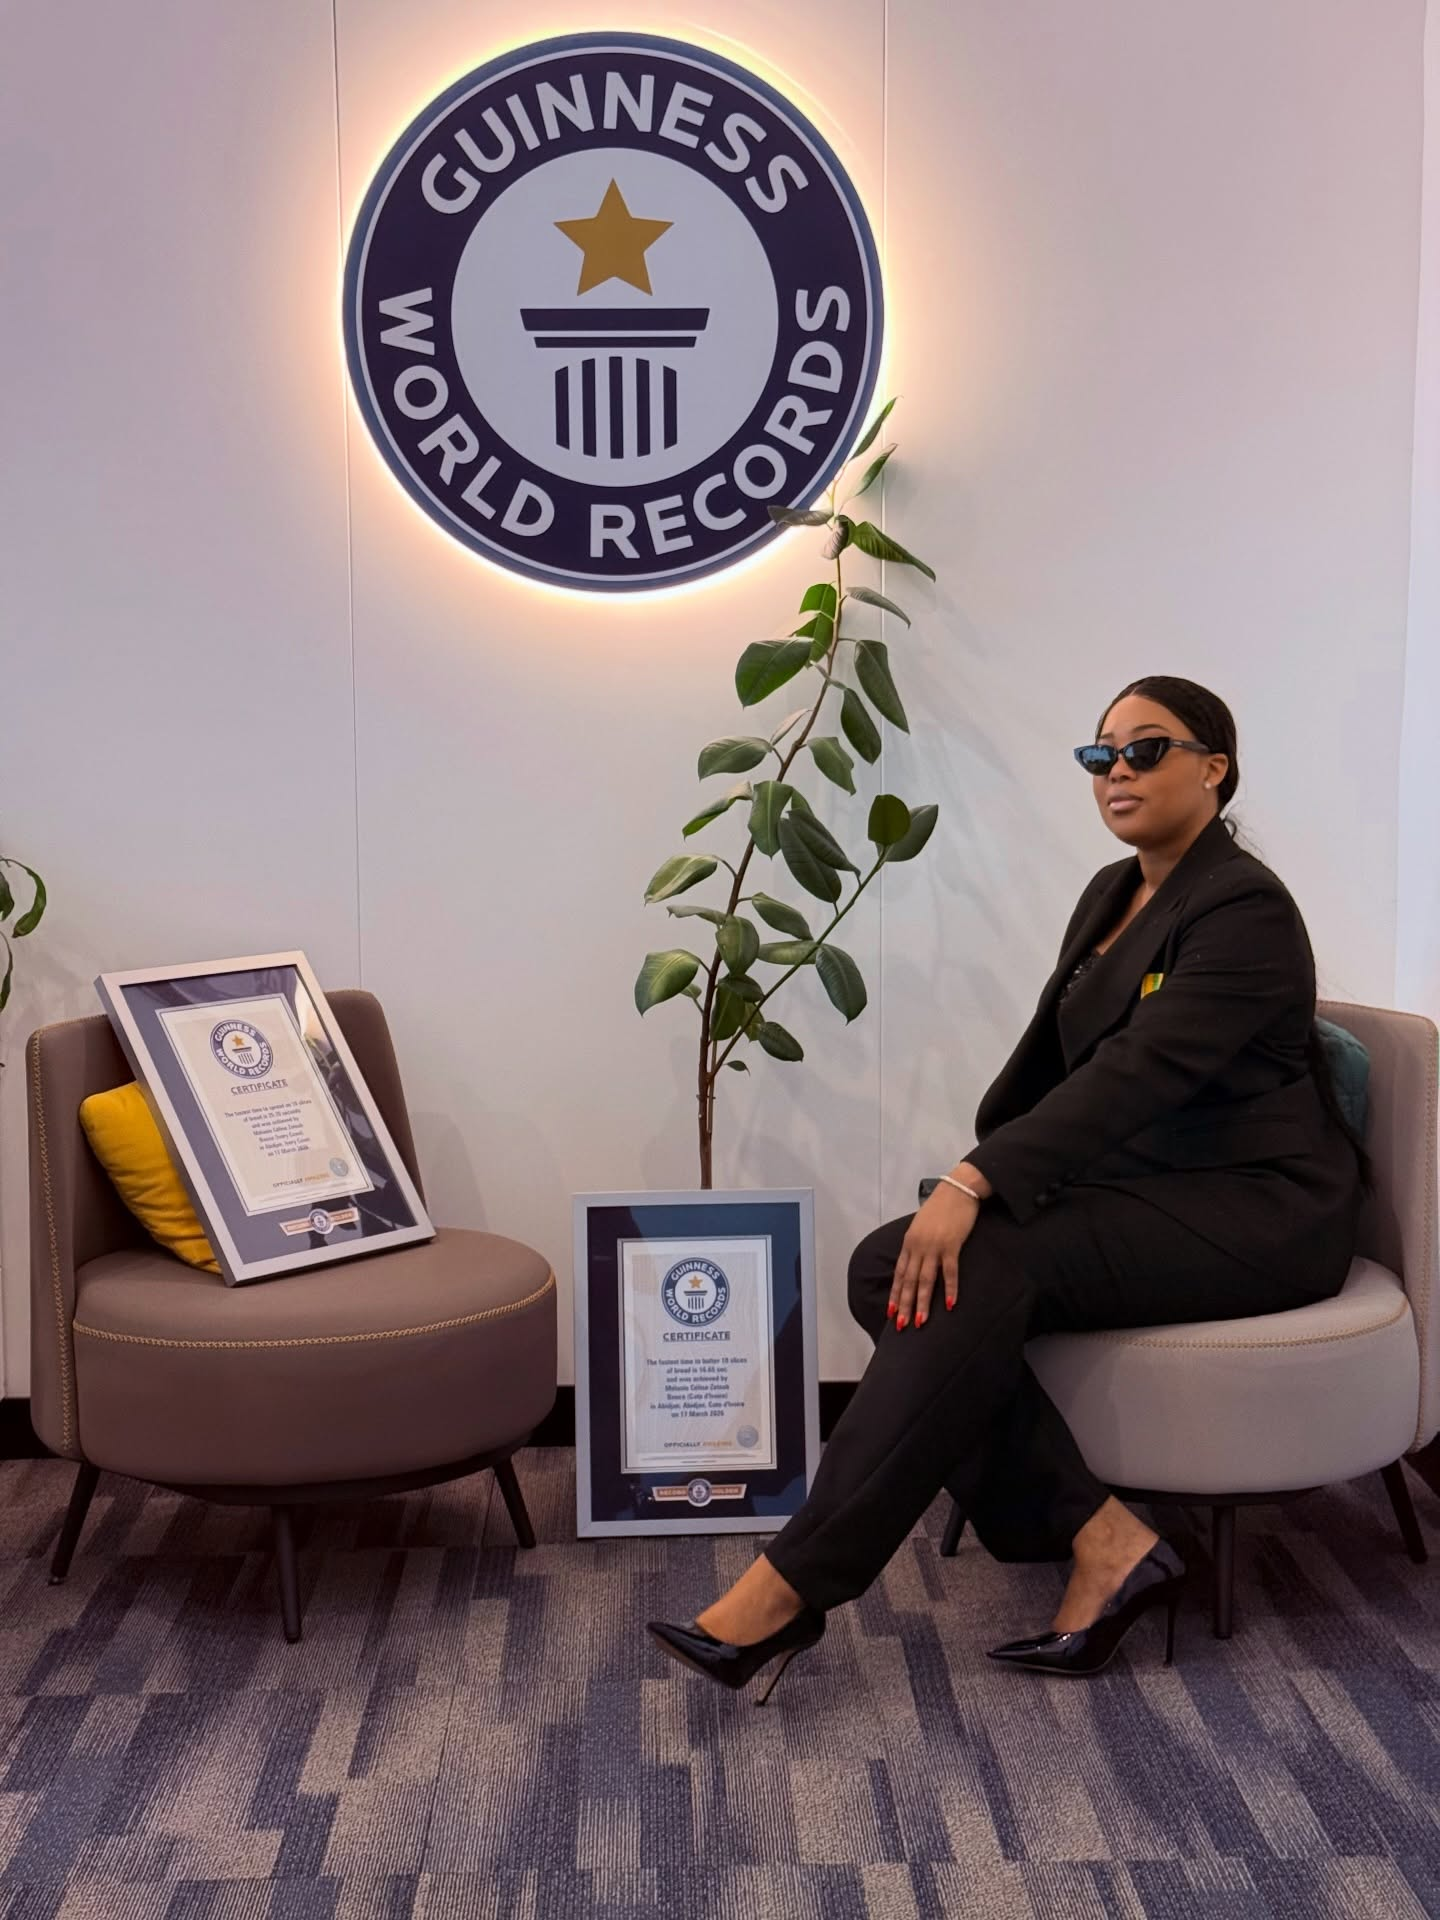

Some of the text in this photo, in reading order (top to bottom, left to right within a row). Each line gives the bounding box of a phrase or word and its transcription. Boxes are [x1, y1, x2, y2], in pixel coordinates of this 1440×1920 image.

[422, 71, 808, 214] GUINNESS
[379, 285, 850, 559] WORLD RECORDS
[215, 1023, 256, 1041] GUINNESS
[215, 1041, 272, 1076] WORLD RECORDS
[231, 1079, 288, 1095] CERTIFICATE
[272, 1118, 293, 1126] achieved
[671, 1261, 721, 1281] GUINNESS
[665, 1287, 726, 1323] WORLD RECORDS
[663, 1331, 731, 1341] CERTIFICATE
[658, 1358, 679, 1366] fastest
[702, 1357, 720, 1365] butter
[730, 1356, 748, 1364] slices
[720, 1375, 728, 1383] by
